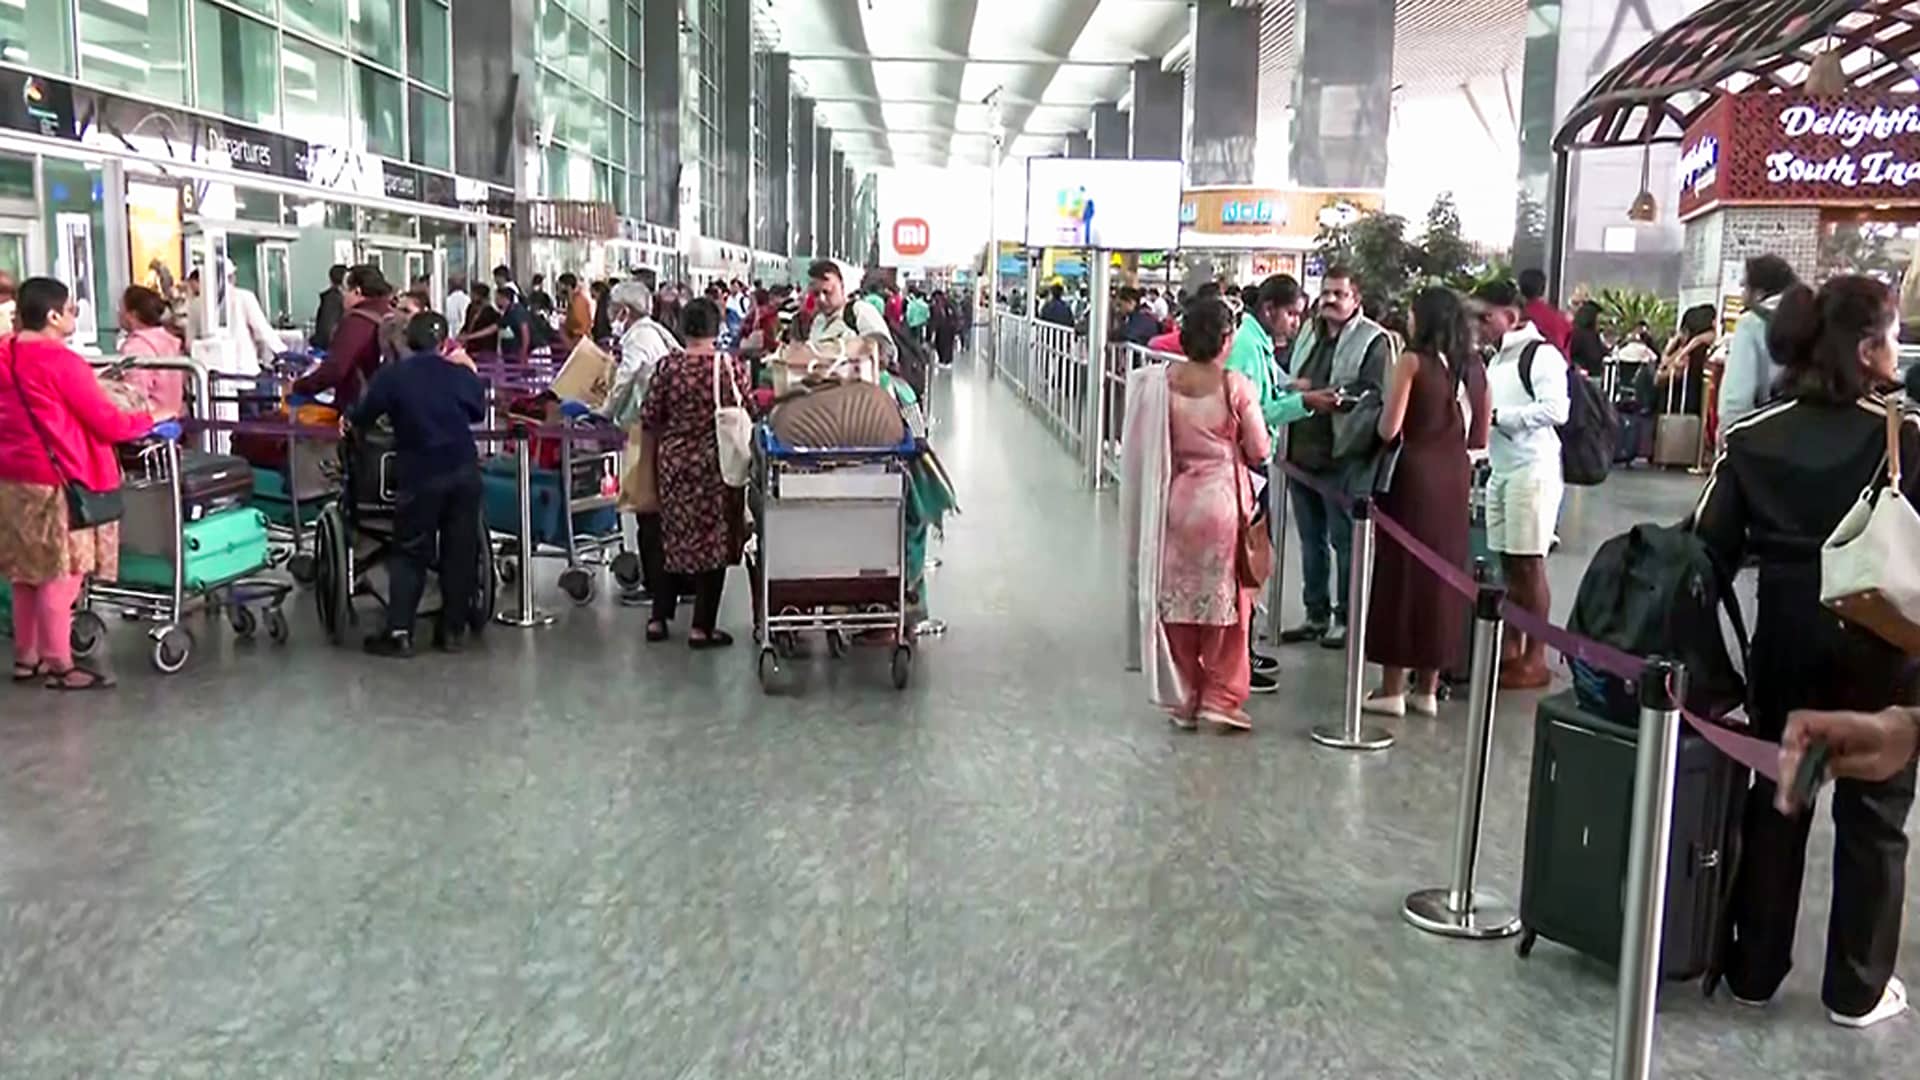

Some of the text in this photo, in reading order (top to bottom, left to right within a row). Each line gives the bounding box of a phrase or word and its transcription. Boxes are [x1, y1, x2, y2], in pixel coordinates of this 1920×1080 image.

[207, 127, 272, 166] Departures
[1765, 150, 1857, 186] South
[182, 184, 194, 209] 6
[898, 225, 926, 245] mi
